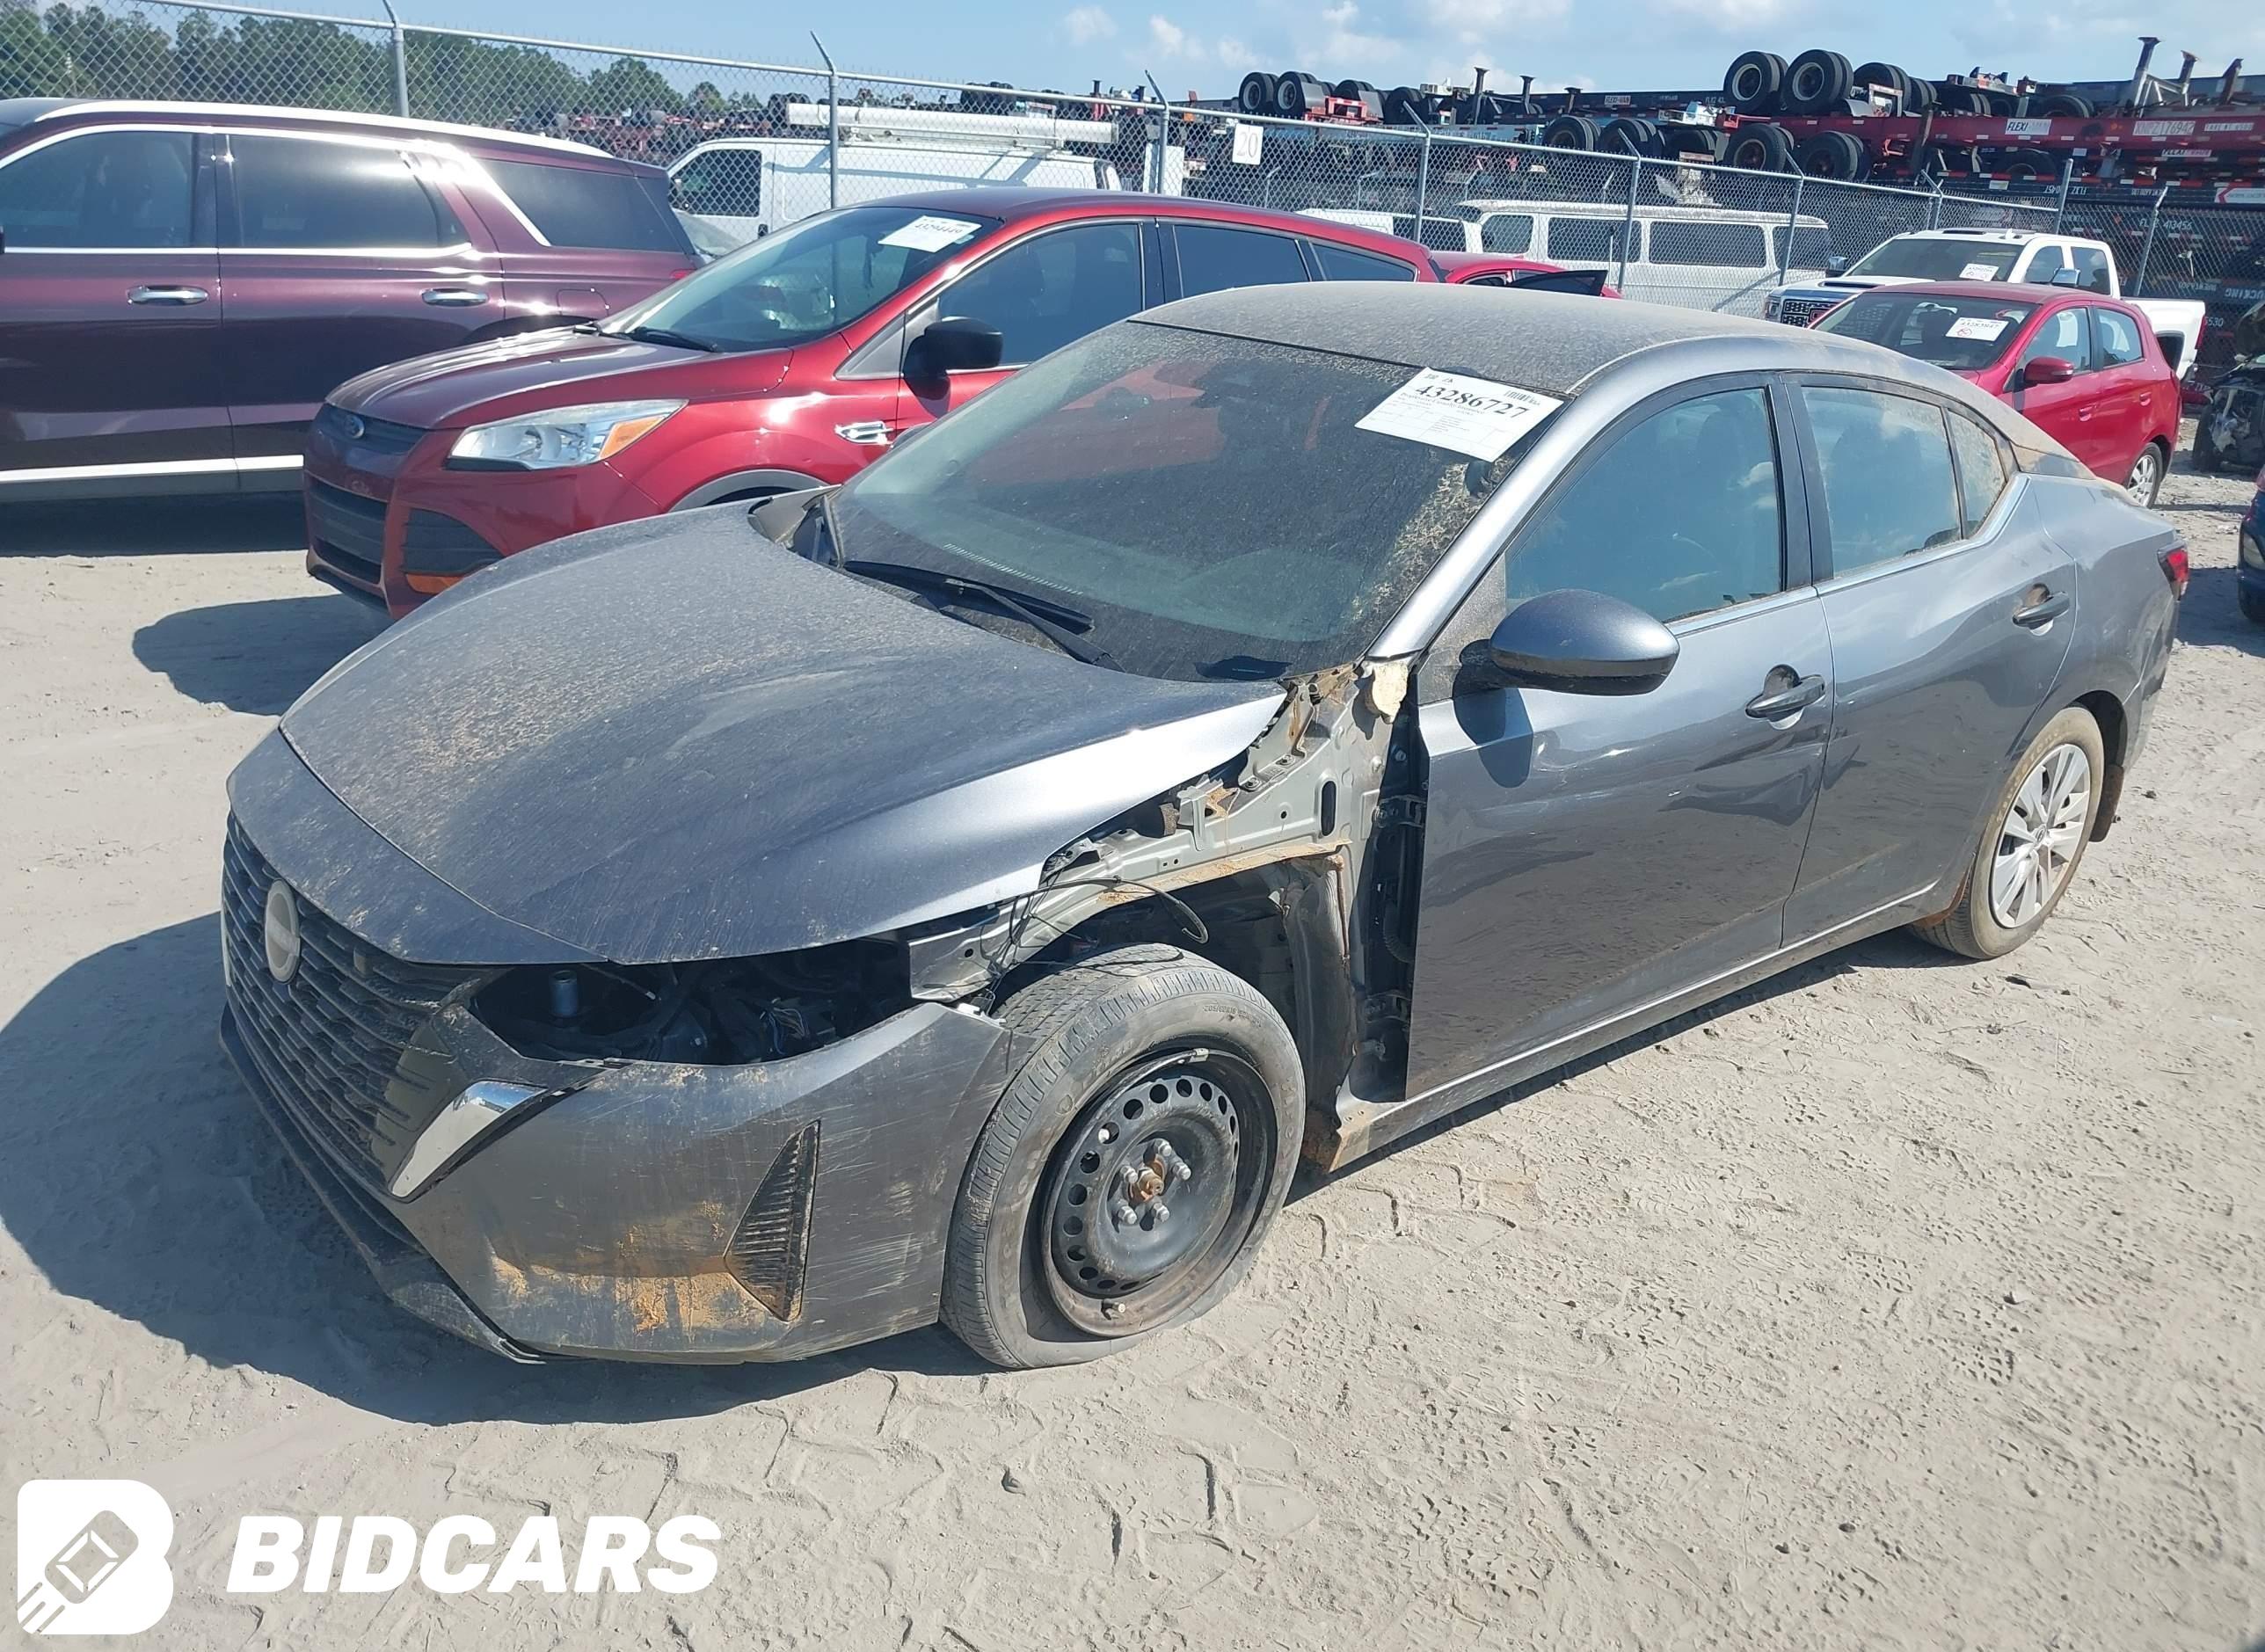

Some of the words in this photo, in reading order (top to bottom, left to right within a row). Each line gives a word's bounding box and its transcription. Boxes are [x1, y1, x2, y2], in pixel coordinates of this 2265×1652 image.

[2006, 121, 2029, 132] FLEXI
[1236, 132, 1259, 158] 20
[1415, 384, 1530, 418] 43286727
